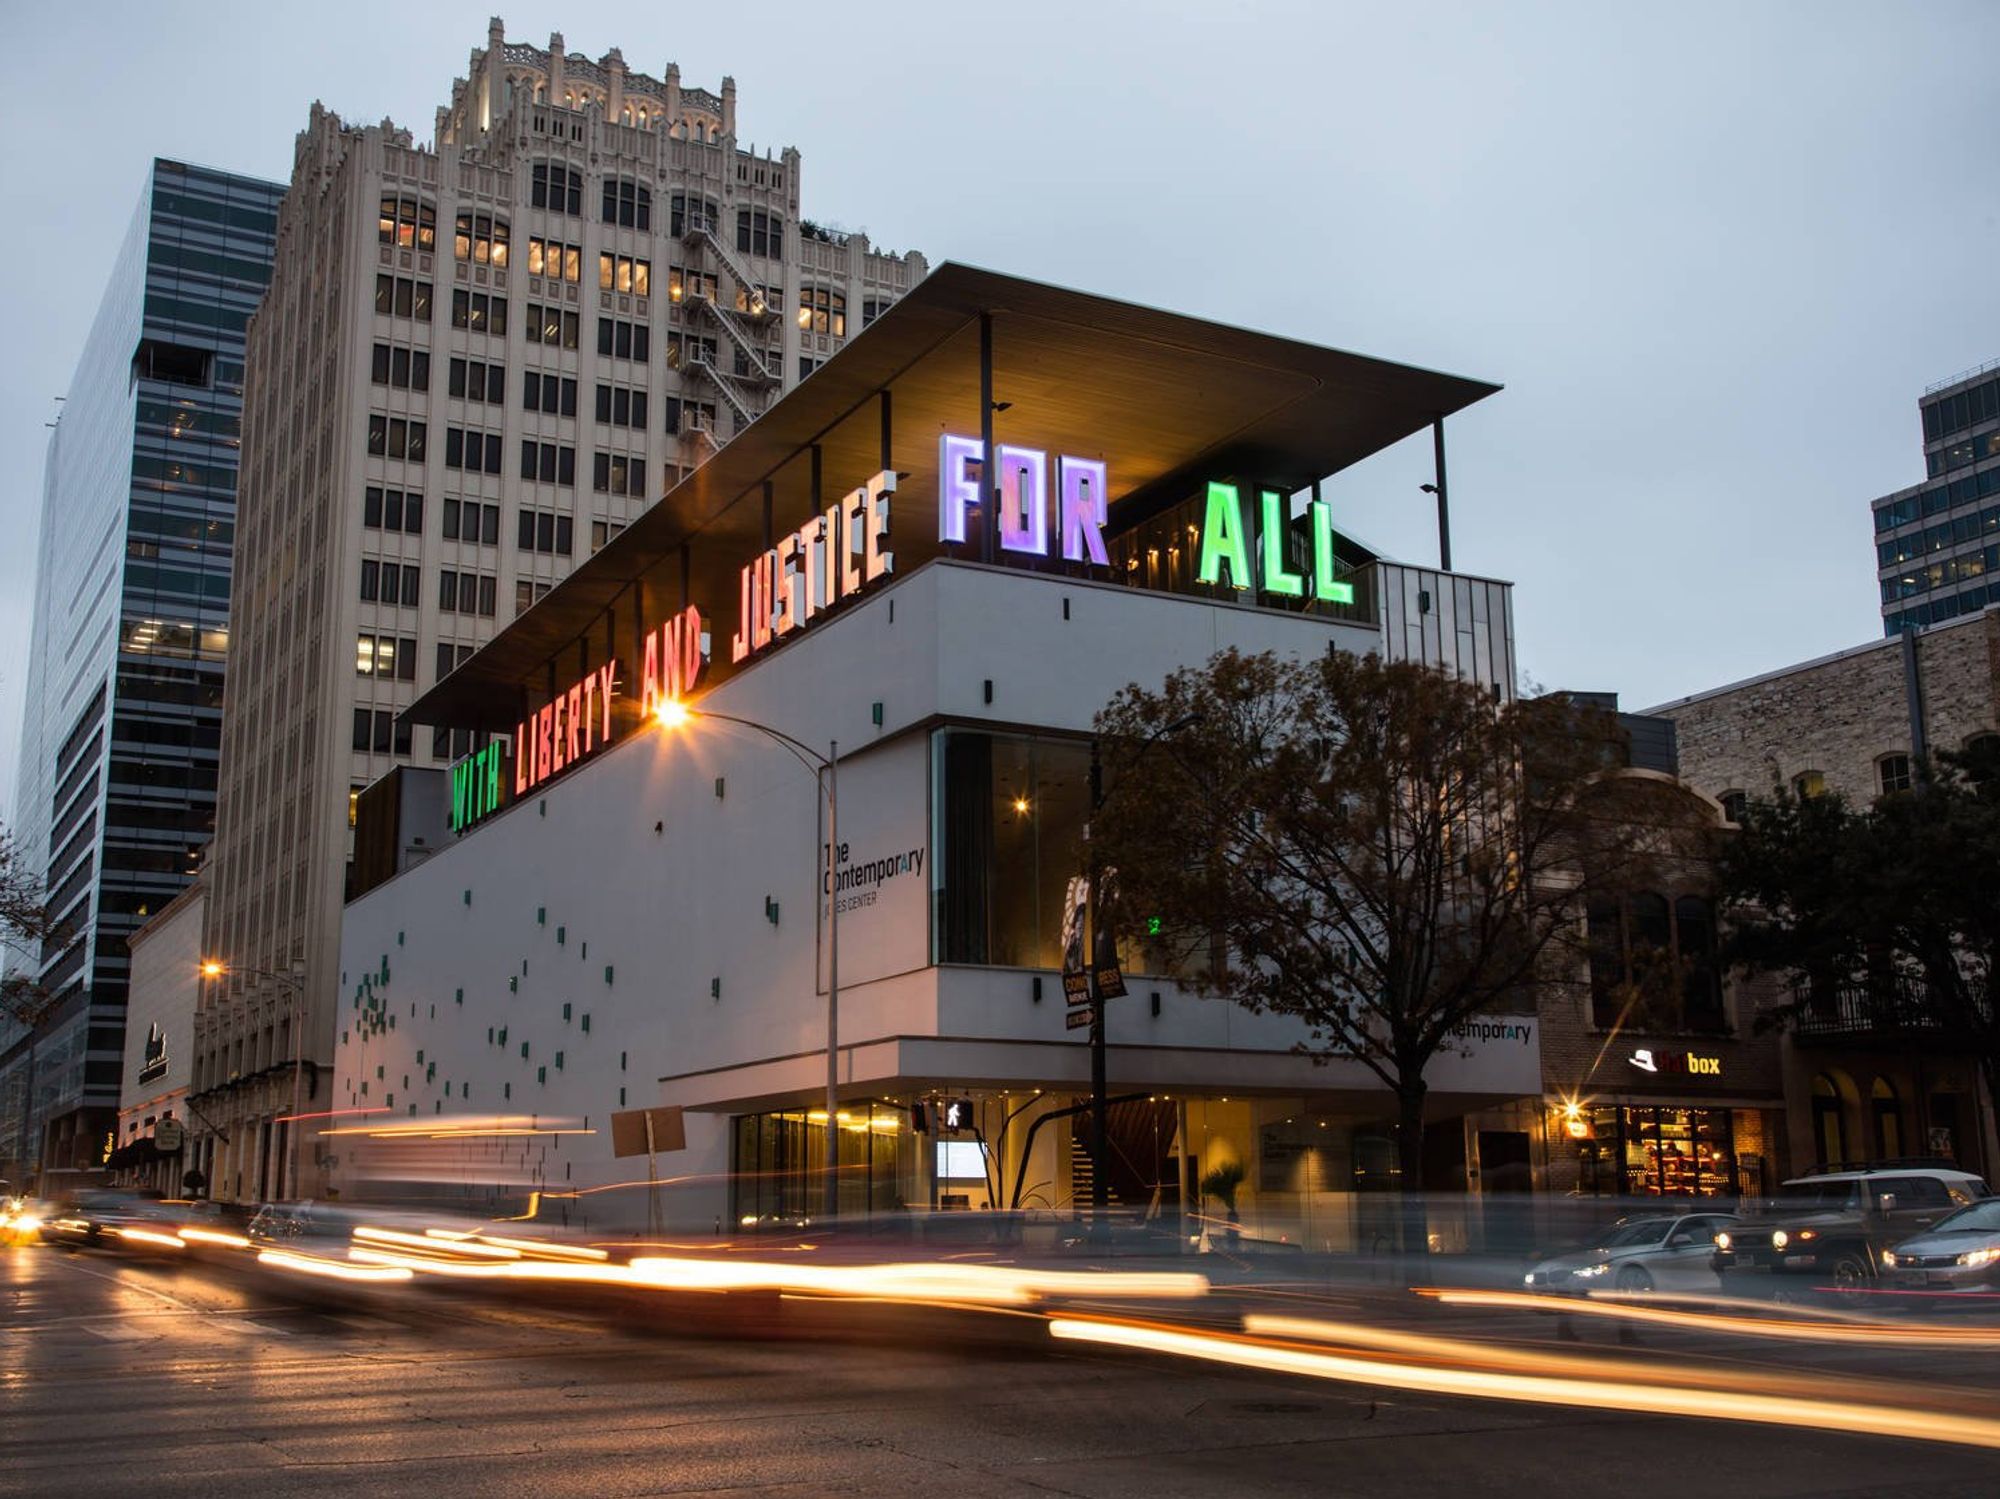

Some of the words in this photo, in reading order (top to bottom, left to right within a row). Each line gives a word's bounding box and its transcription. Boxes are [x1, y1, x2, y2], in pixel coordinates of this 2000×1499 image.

[452, 739, 502, 834] WITH
[514, 657, 618, 798] LIBERTY
[640, 603, 712, 719] AND
[732, 469, 899, 666] JUSTICE
[938, 432, 1109, 567] FOR
[1196, 480, 1355, 606] ALL
